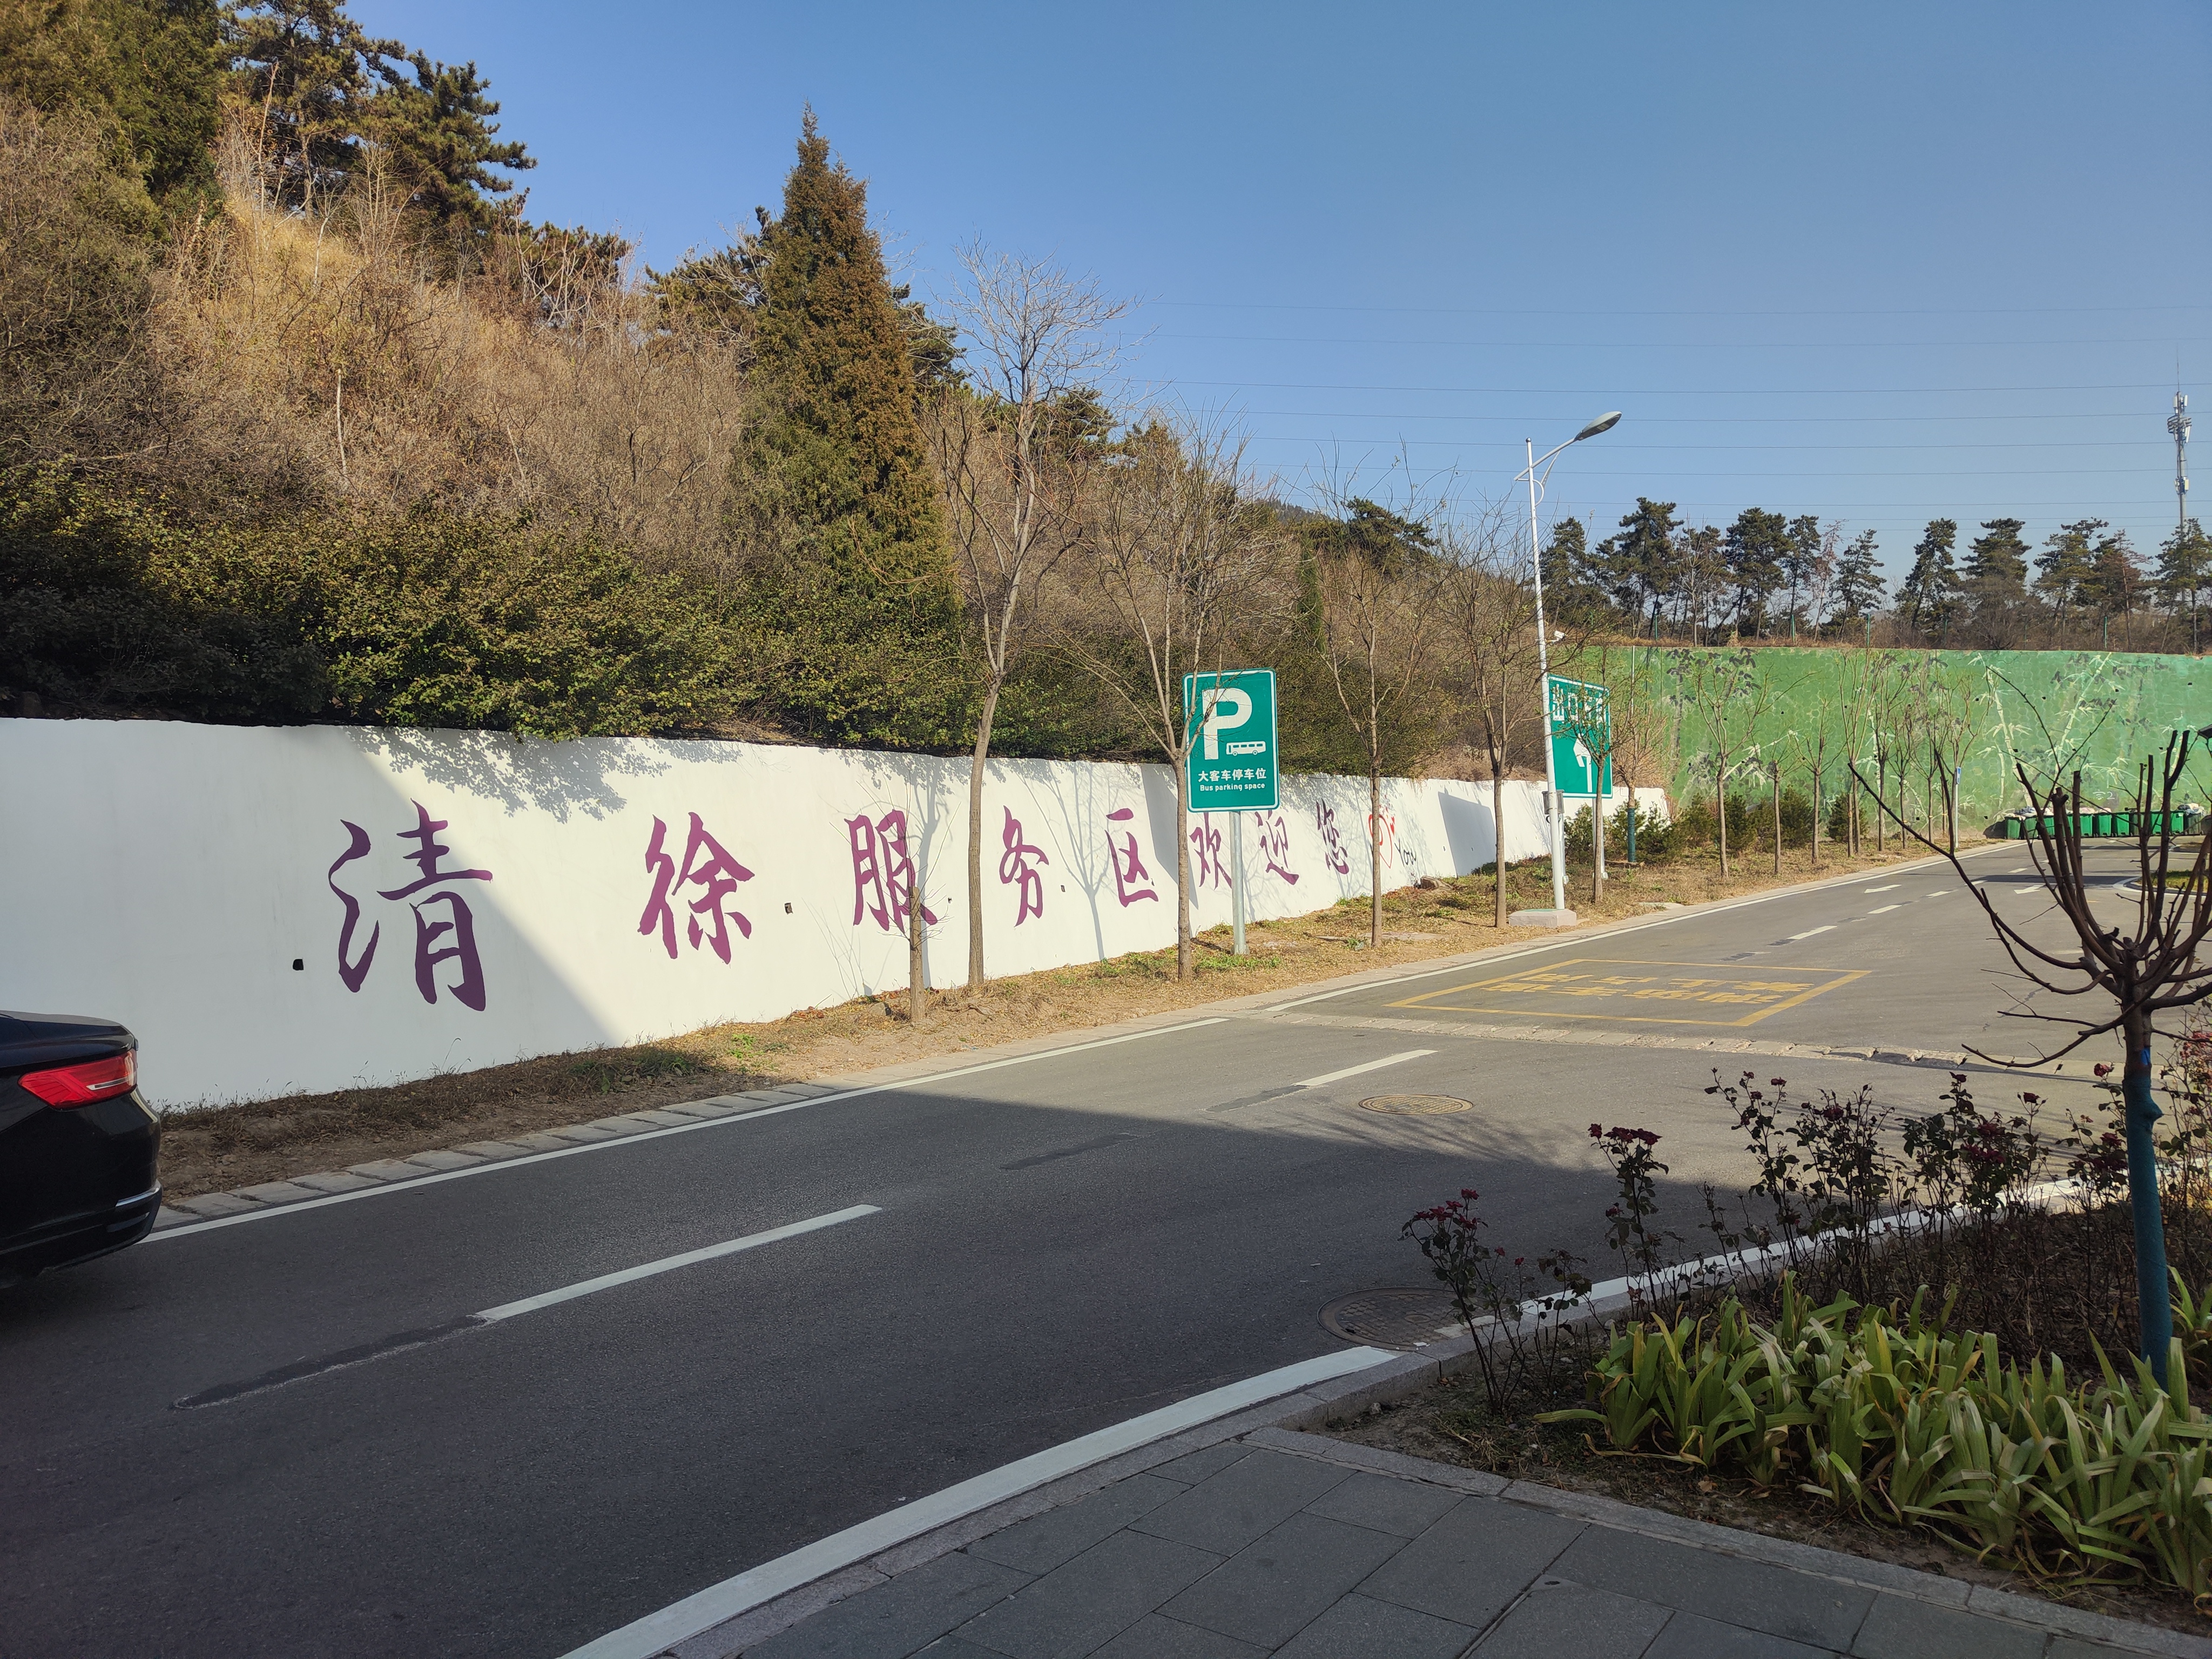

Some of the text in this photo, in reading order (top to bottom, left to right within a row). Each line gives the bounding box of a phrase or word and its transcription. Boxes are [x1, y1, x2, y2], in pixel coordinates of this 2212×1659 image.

[1202, 688, 1253, 760] P
[1198, 767, 1267, 782] 大客车停车位
[1215, 783, 1243, 792] parking
